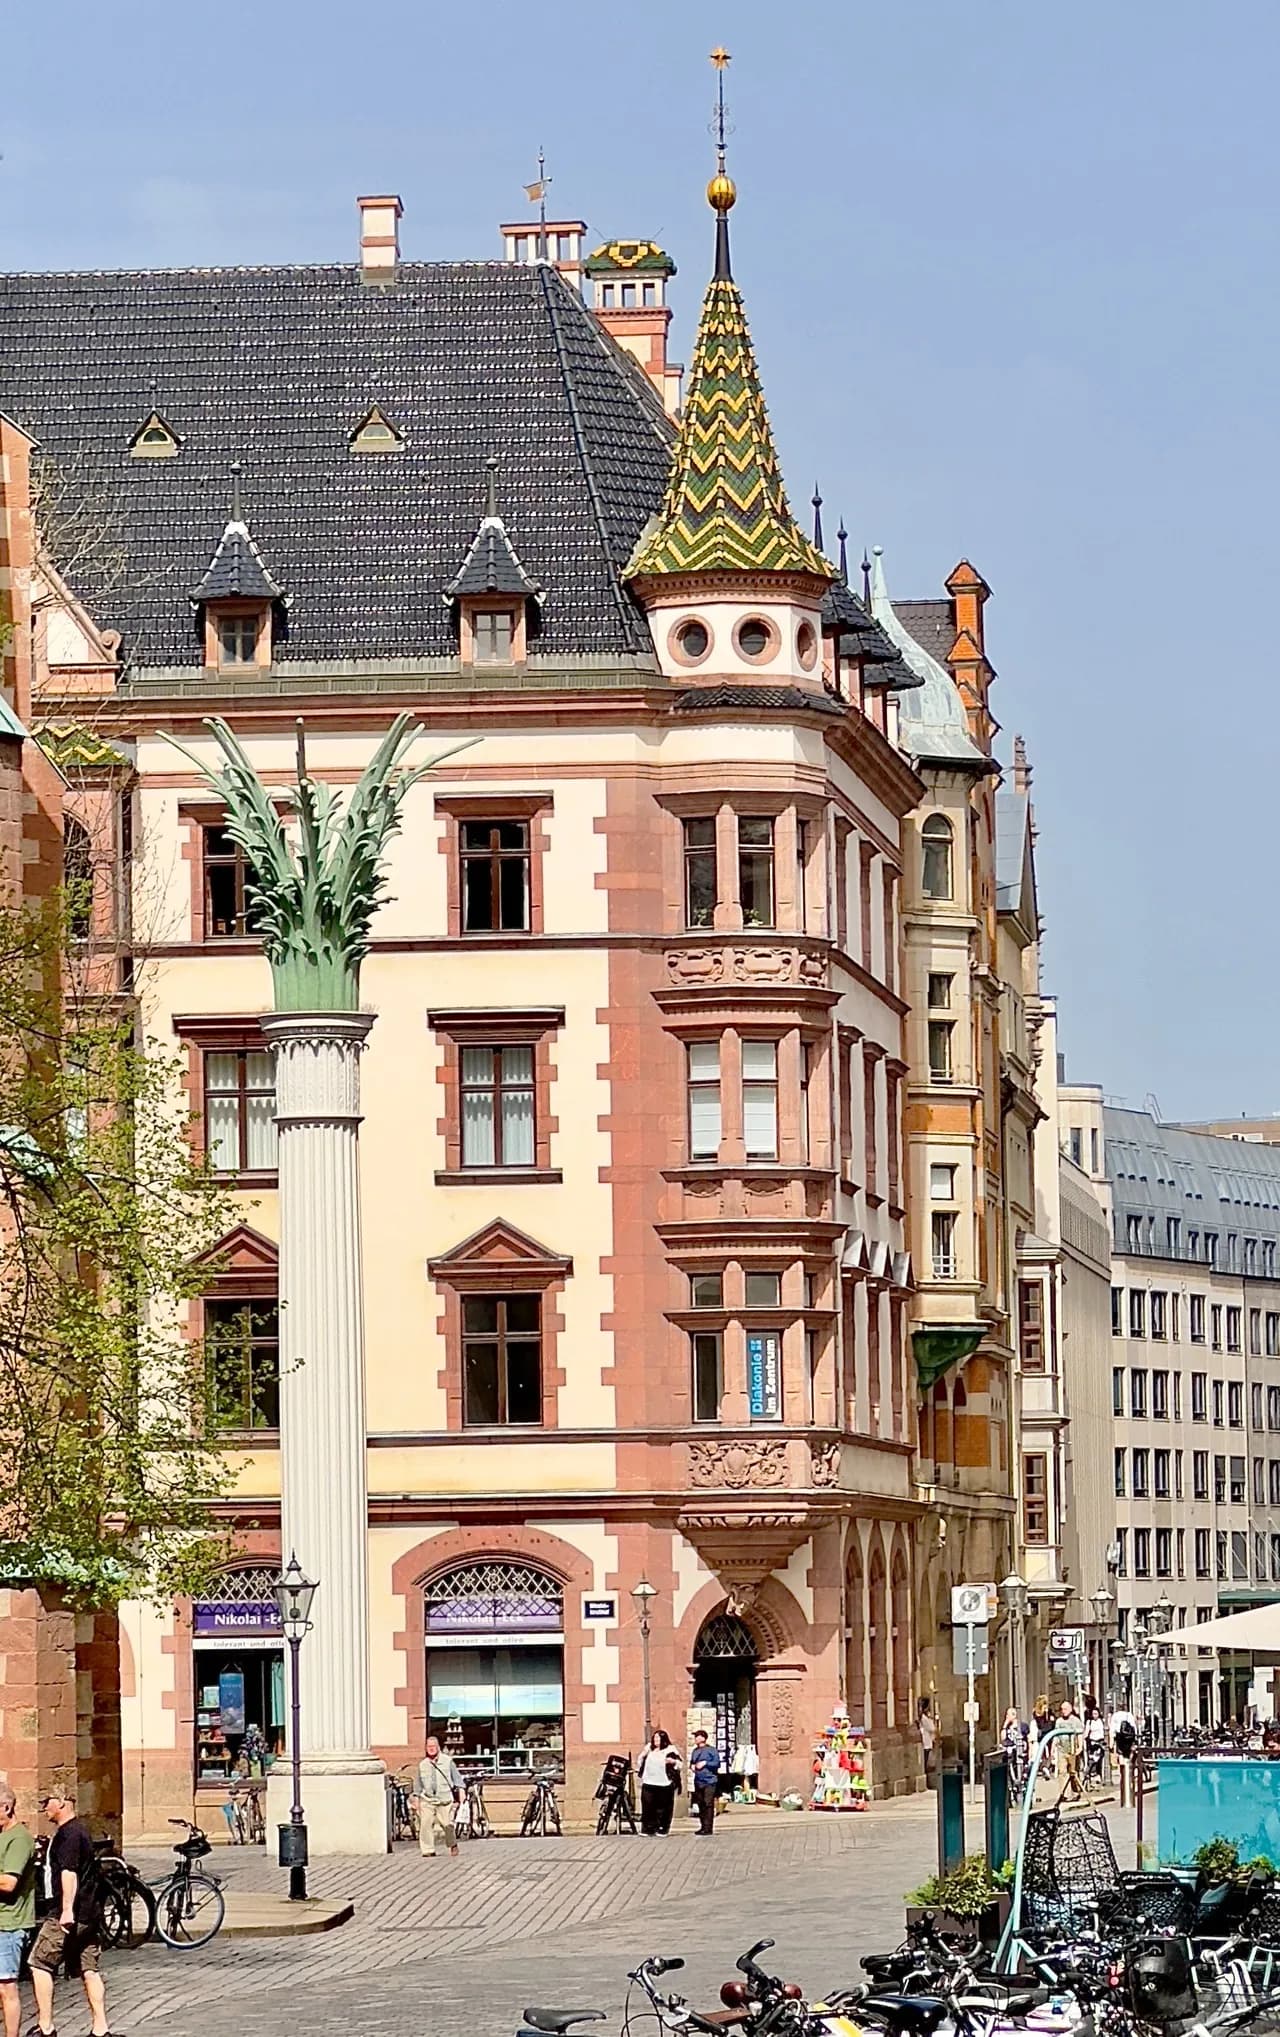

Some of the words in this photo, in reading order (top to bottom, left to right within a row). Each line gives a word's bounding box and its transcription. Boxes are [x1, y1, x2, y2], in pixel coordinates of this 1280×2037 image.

[752, 1353, 763, 1413] Diakonie
[765, 1339, 776, 1393] Zentrum
[214, 1613, 260, 1625] Nikolai
